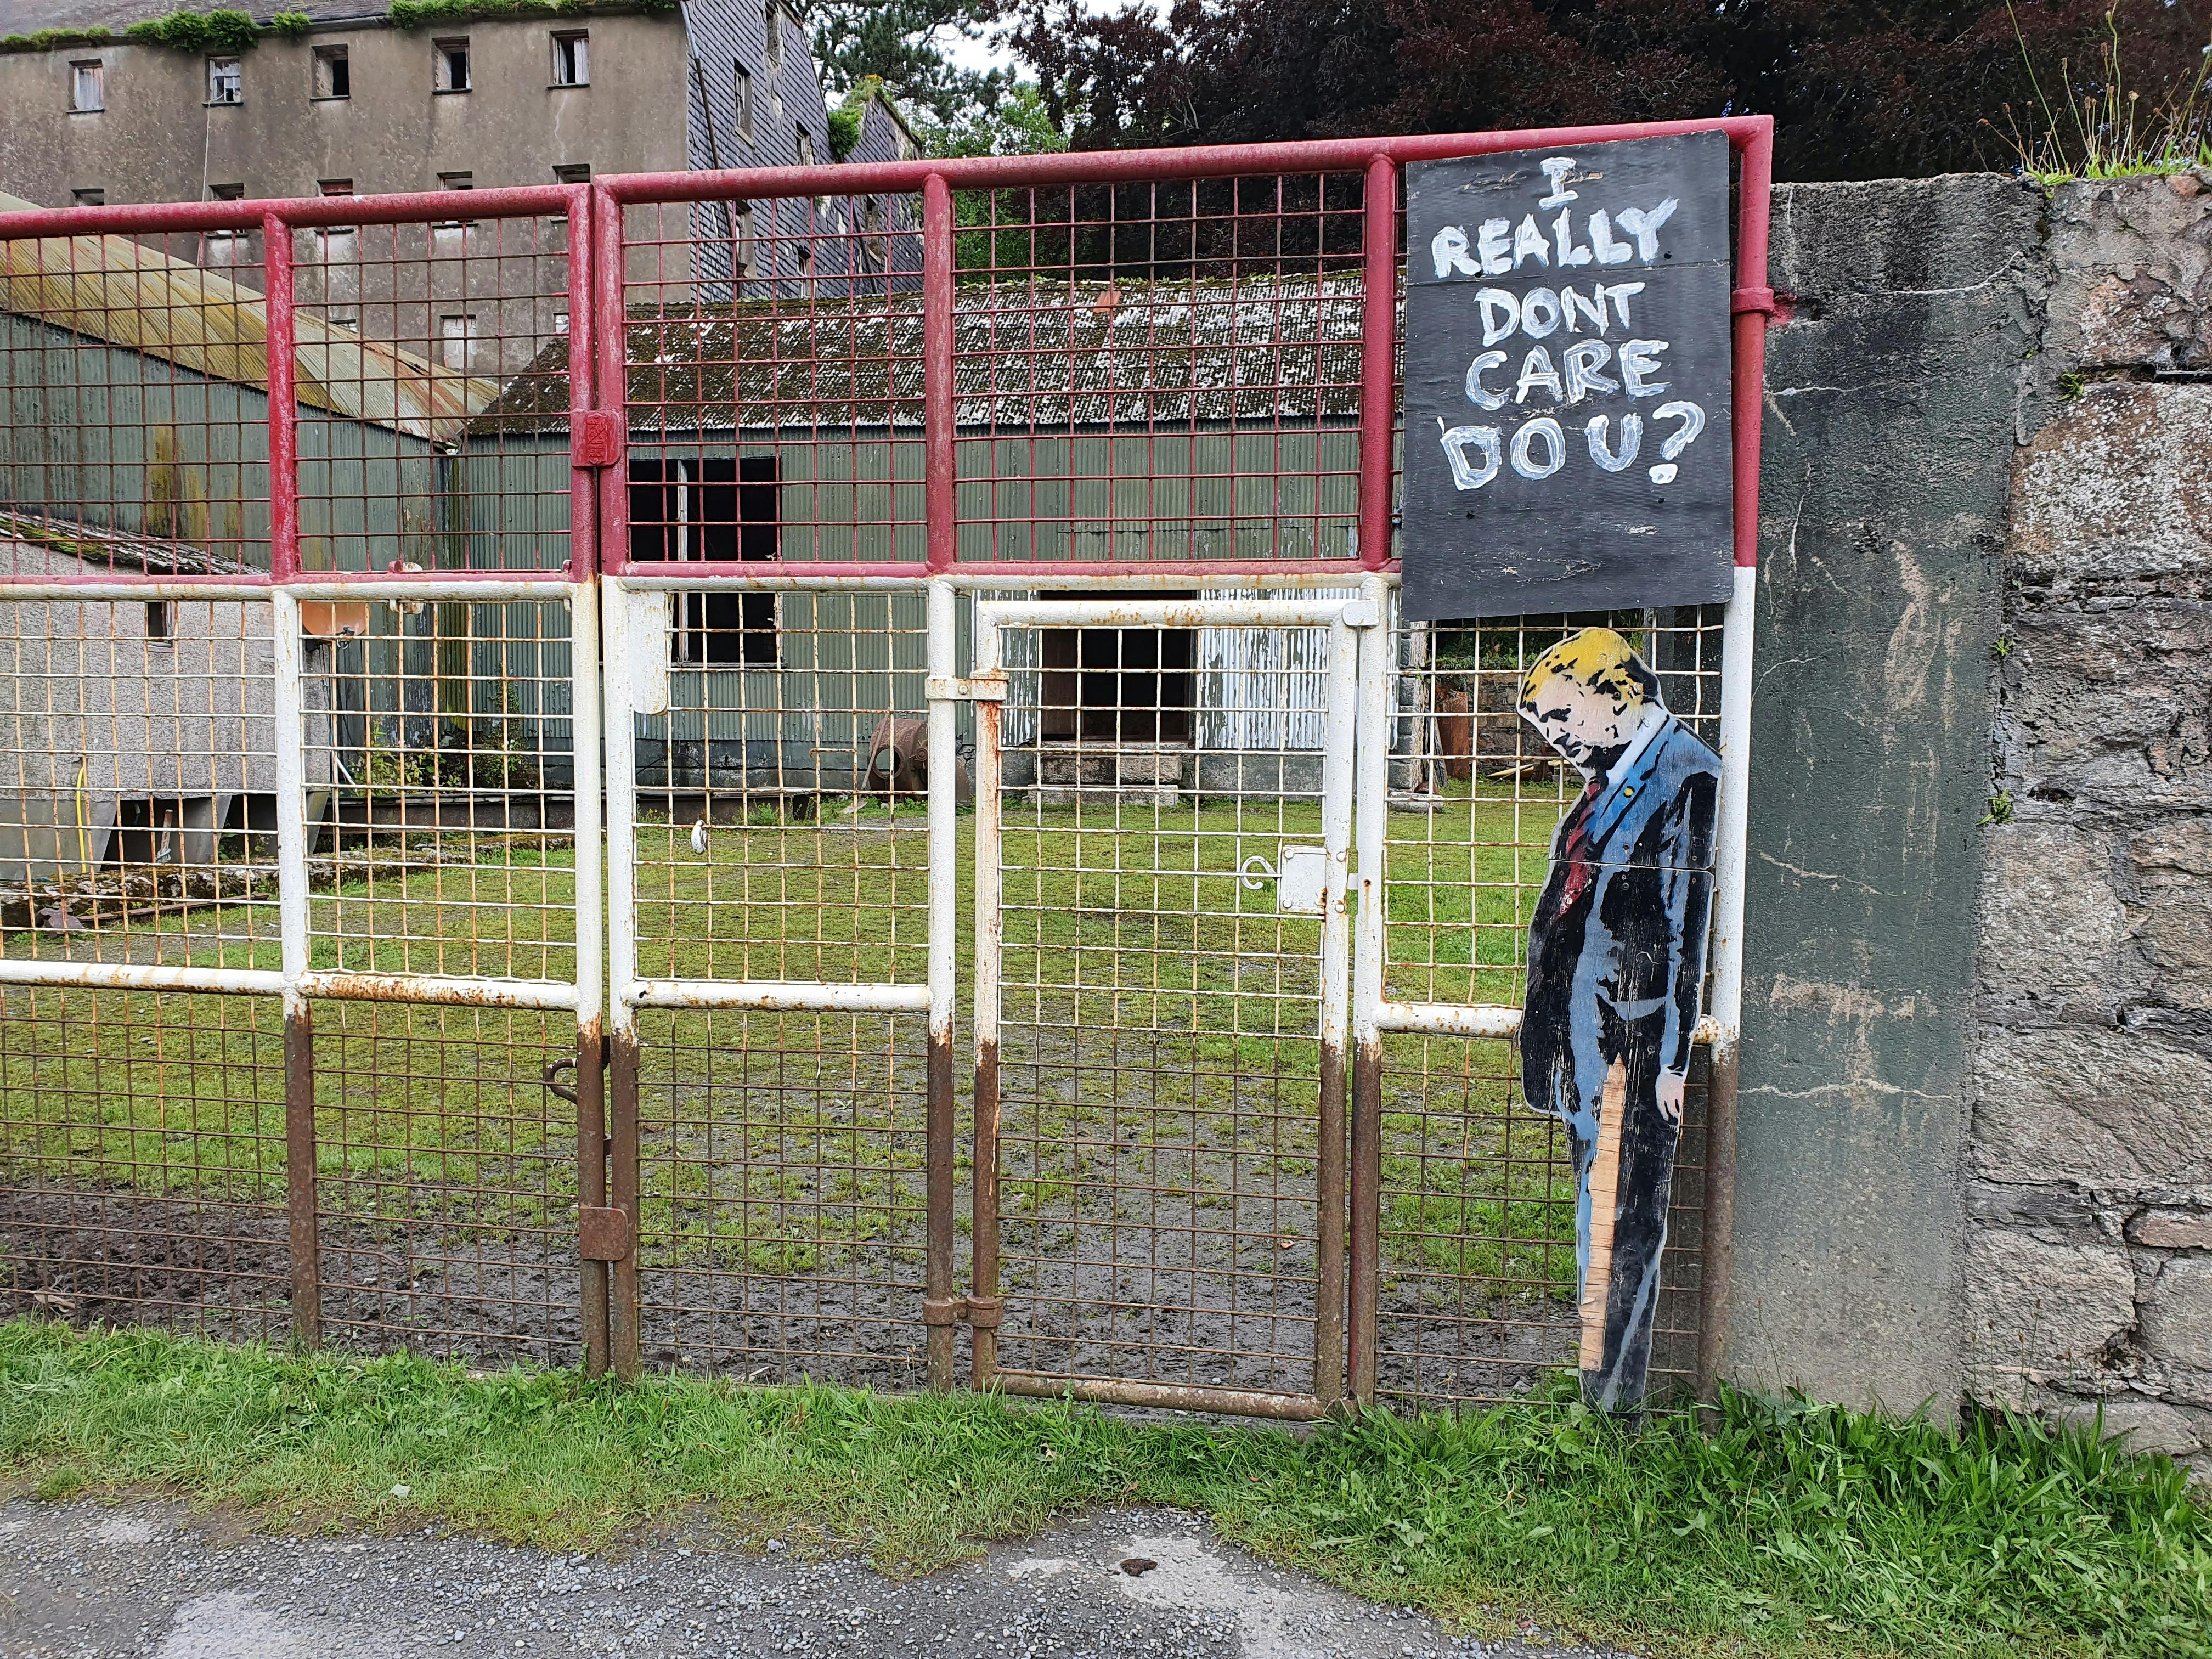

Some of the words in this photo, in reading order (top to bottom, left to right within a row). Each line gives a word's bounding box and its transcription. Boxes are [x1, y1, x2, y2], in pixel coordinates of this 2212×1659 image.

[1539, 157, 1580, 210] I
[1431, 196, 1680, 278] REALLY
[1474, 281, 1646, 347] DONT
[1465, 339, 1672, 411] CARE
[1438, 417, 1566, 491] DO
